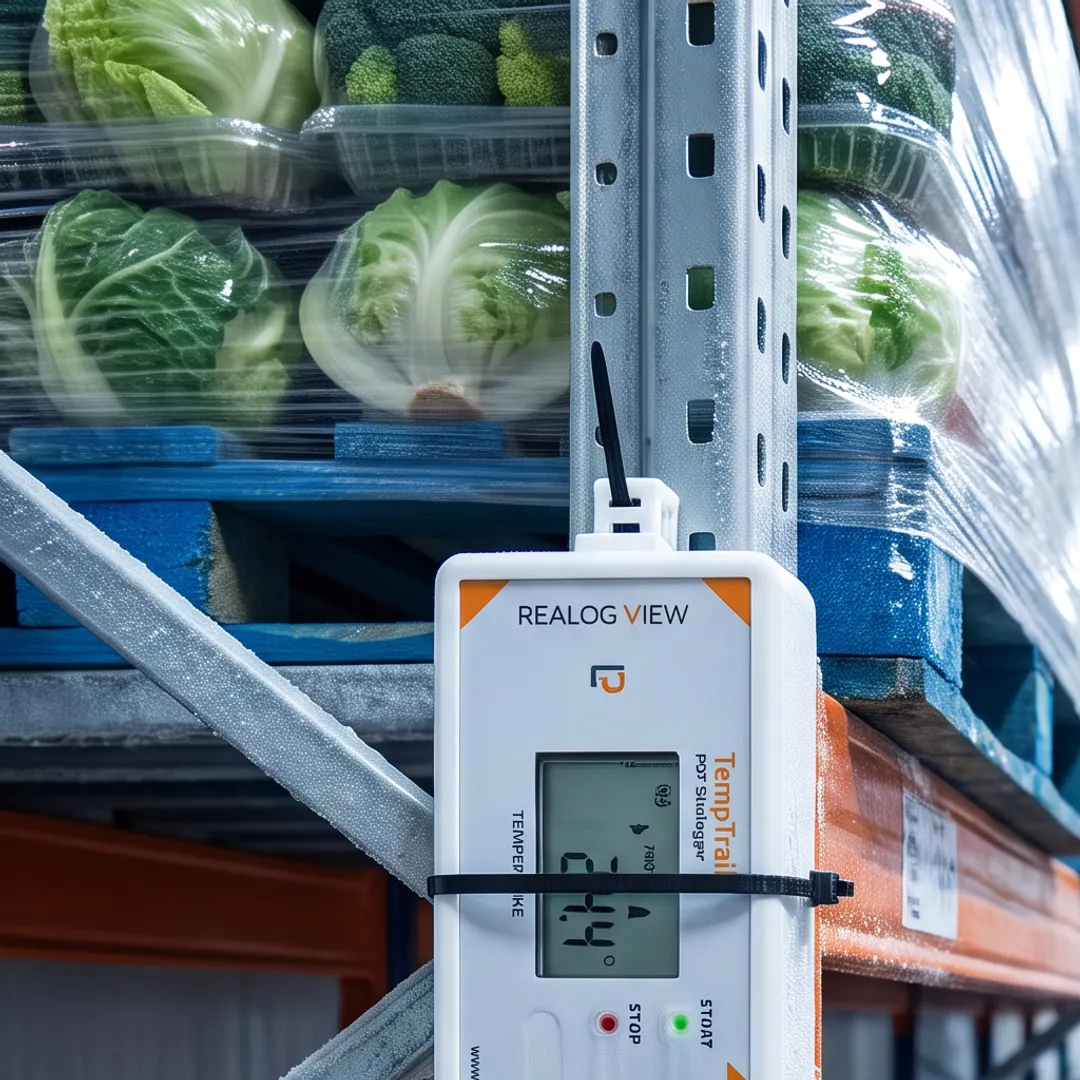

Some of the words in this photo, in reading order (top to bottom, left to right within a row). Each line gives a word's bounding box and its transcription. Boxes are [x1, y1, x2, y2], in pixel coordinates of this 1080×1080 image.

[518, 604, 618, 626] REALOG
[622, 604, 689, 626] VIEW
[628, 1003, 641, 1045] STOP
